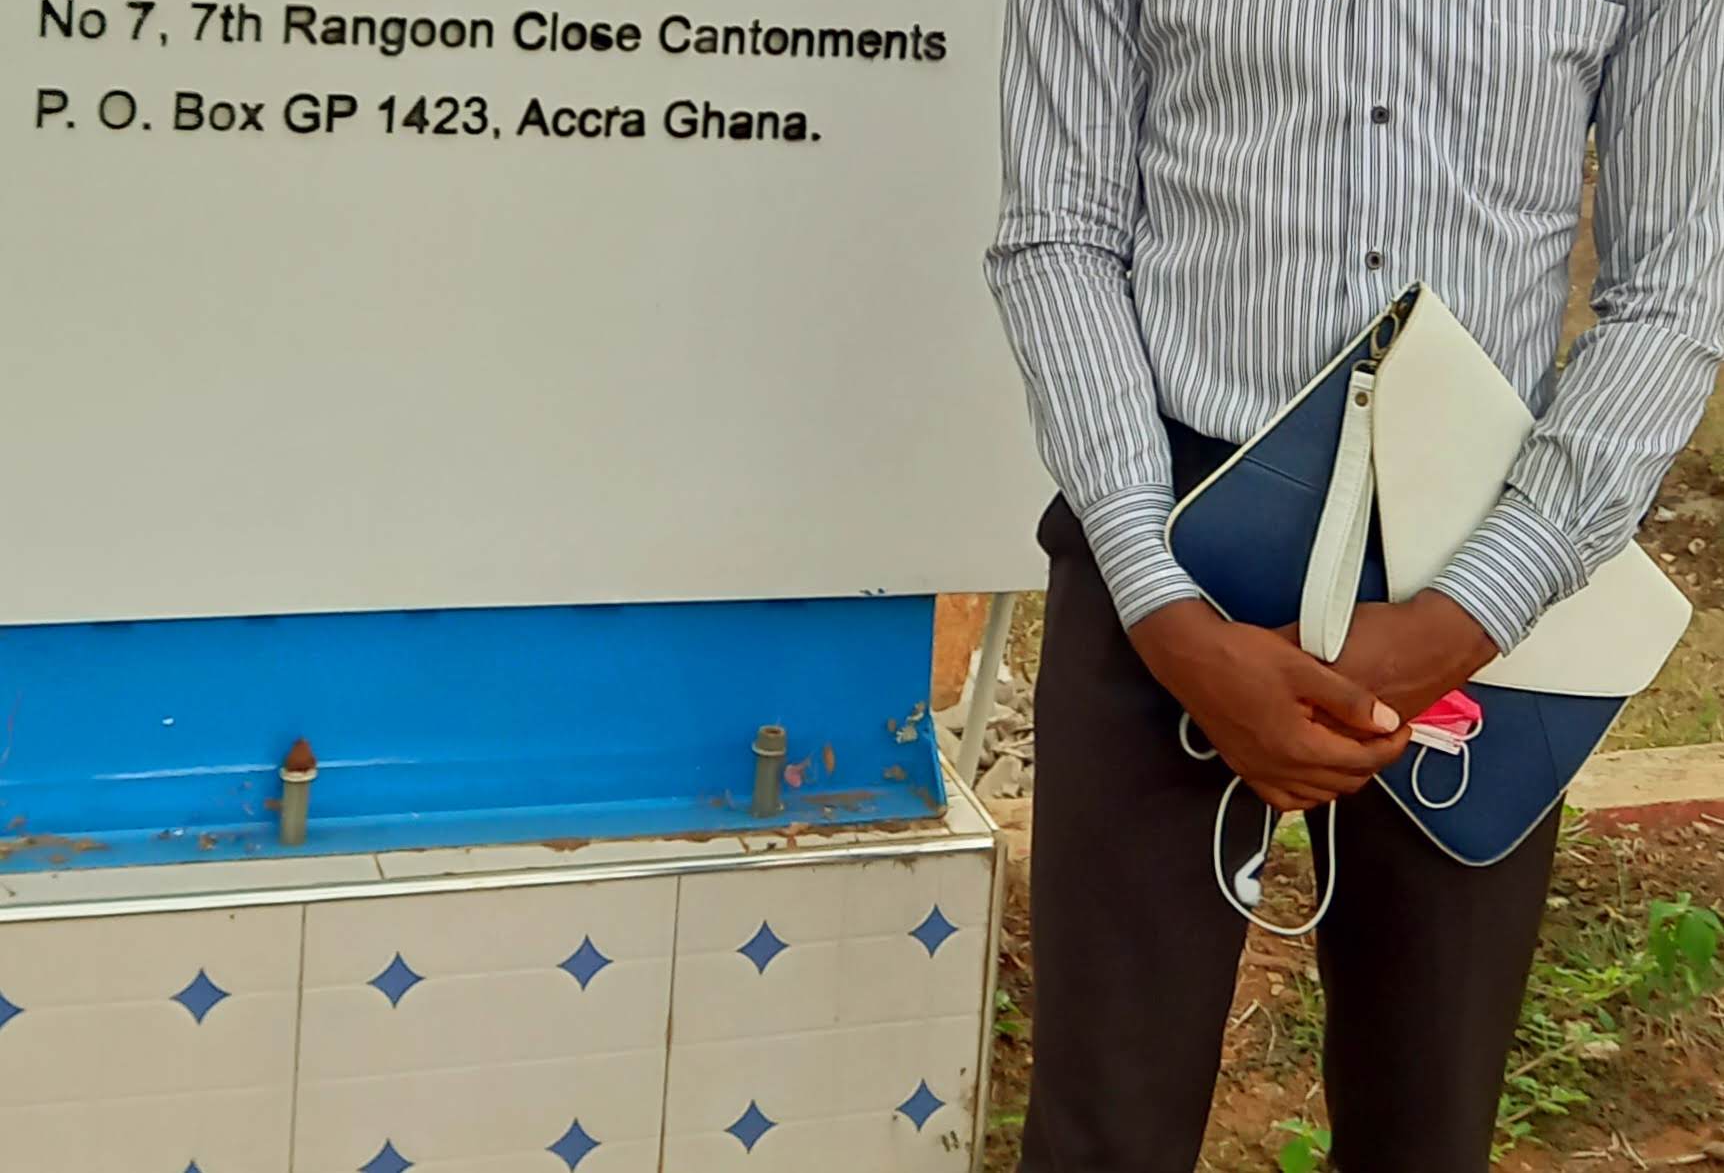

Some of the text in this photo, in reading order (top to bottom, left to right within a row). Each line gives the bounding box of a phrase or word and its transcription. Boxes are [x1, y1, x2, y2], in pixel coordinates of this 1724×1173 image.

[126, 1, 168, 48] 7,
[190, 2, 263, 44] 7th
[282, 4, 495, 58] Rangoon
[512, 10, 642, 53] Close
[657, 14, 948, 63] Cantonments
[35, 88, 823, 144] P. O. Box GP 1423, Accra Ghana.
